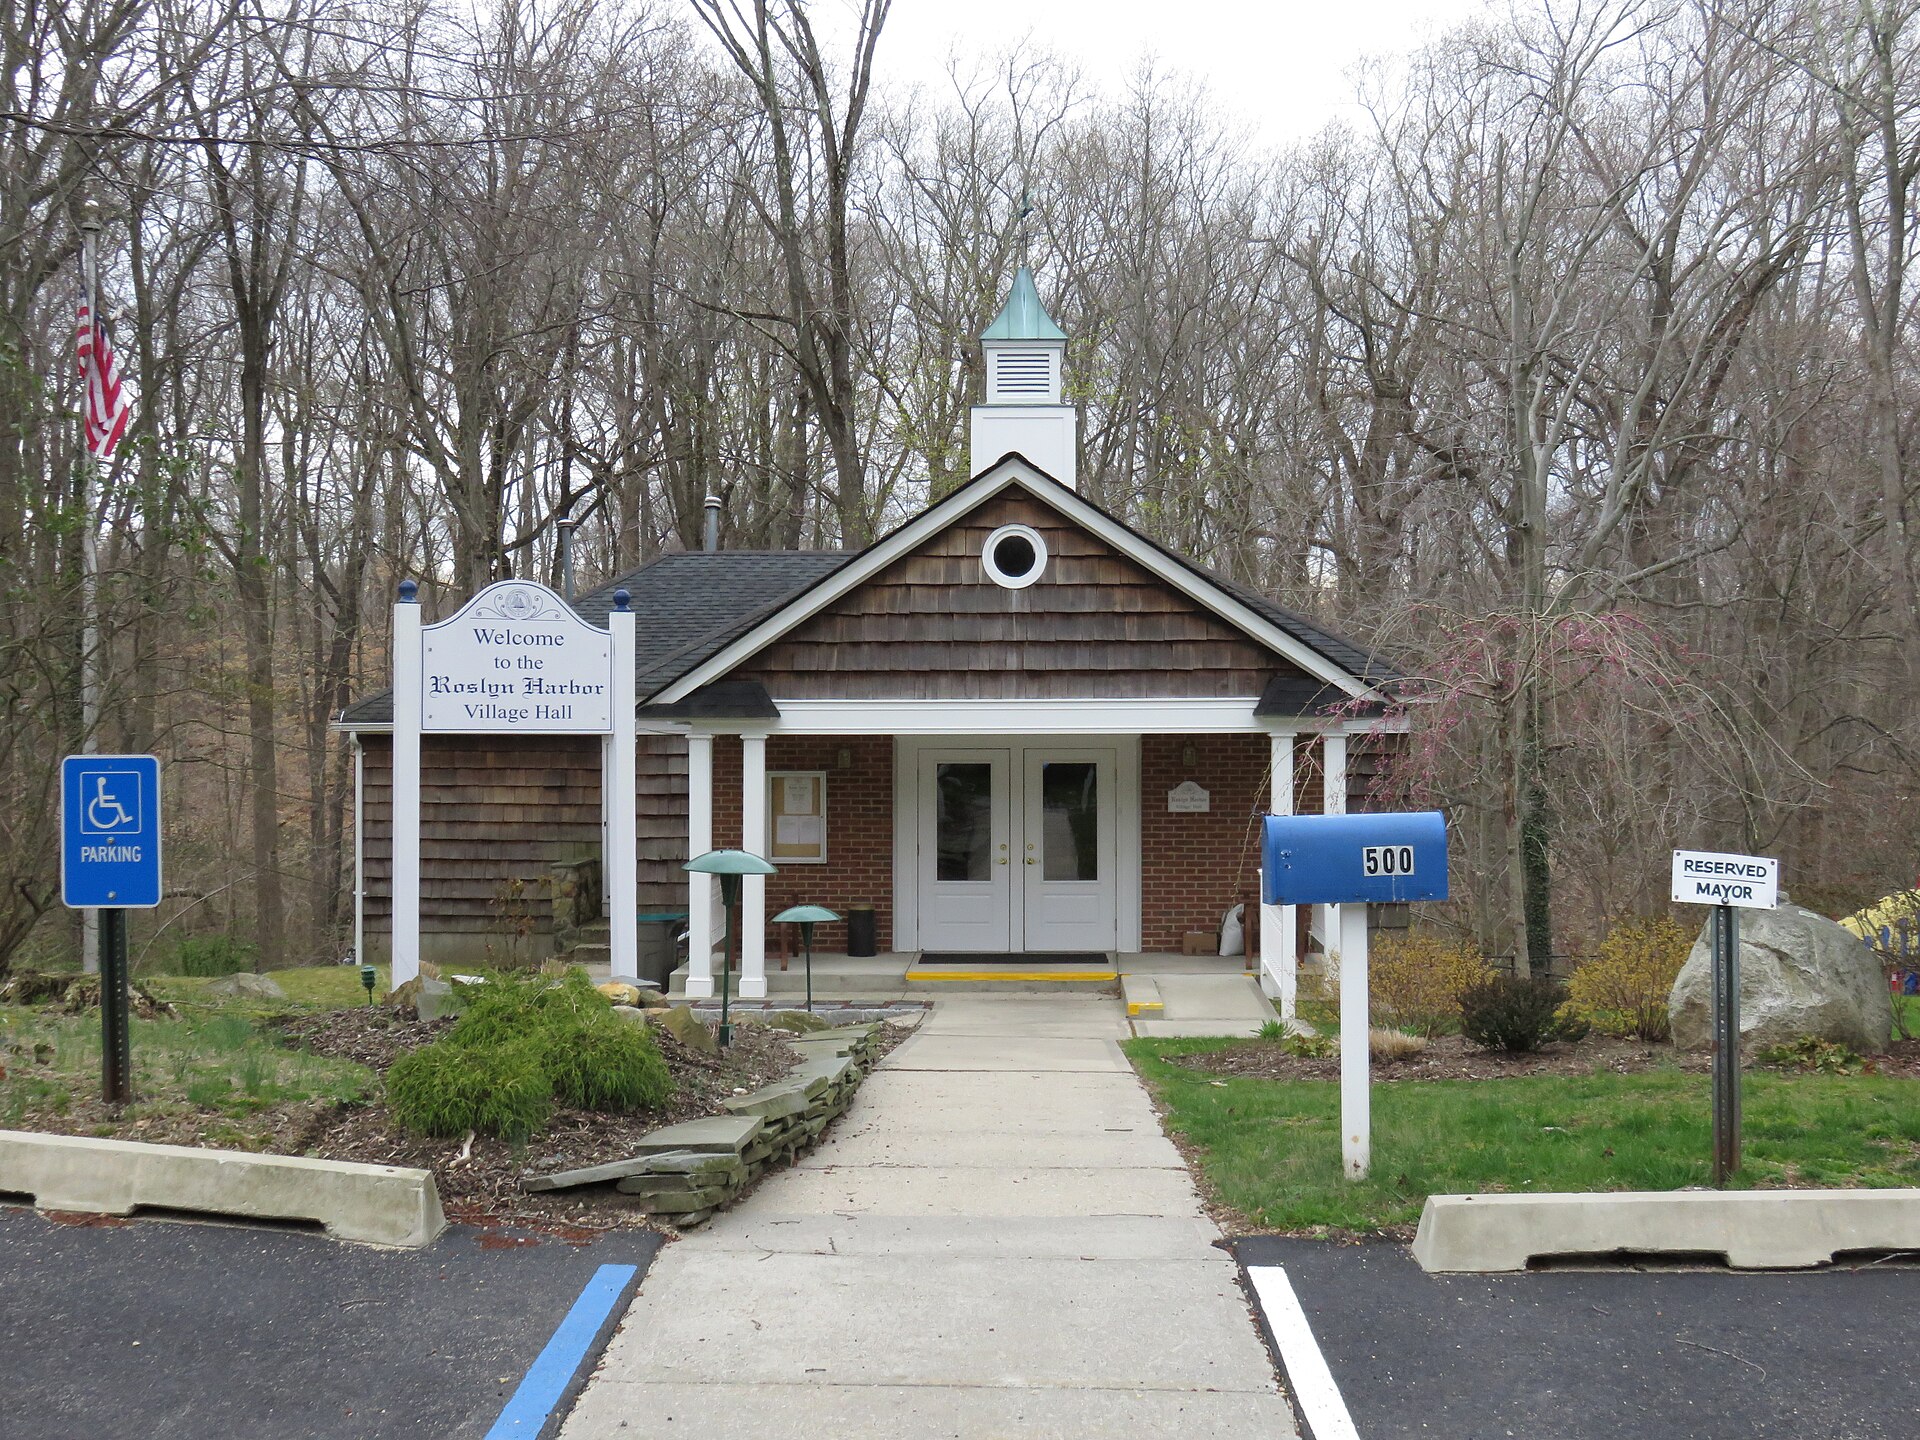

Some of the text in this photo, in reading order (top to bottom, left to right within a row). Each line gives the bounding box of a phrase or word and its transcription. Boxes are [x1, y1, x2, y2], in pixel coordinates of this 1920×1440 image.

[473, 628, 565, 646] Welcome
[494, 655, 544, 670] to the
[429, 676, 605, 699] Roslyn Harbor
[464, 704, 573, 723] Village Hall
[81, 846, 142, 862] PARKING
[1366, 847, 1412, 874] 500
[1684, 859, 1767, 878] RESERVED
[1696, 882, 1753, 899] MAYOR
